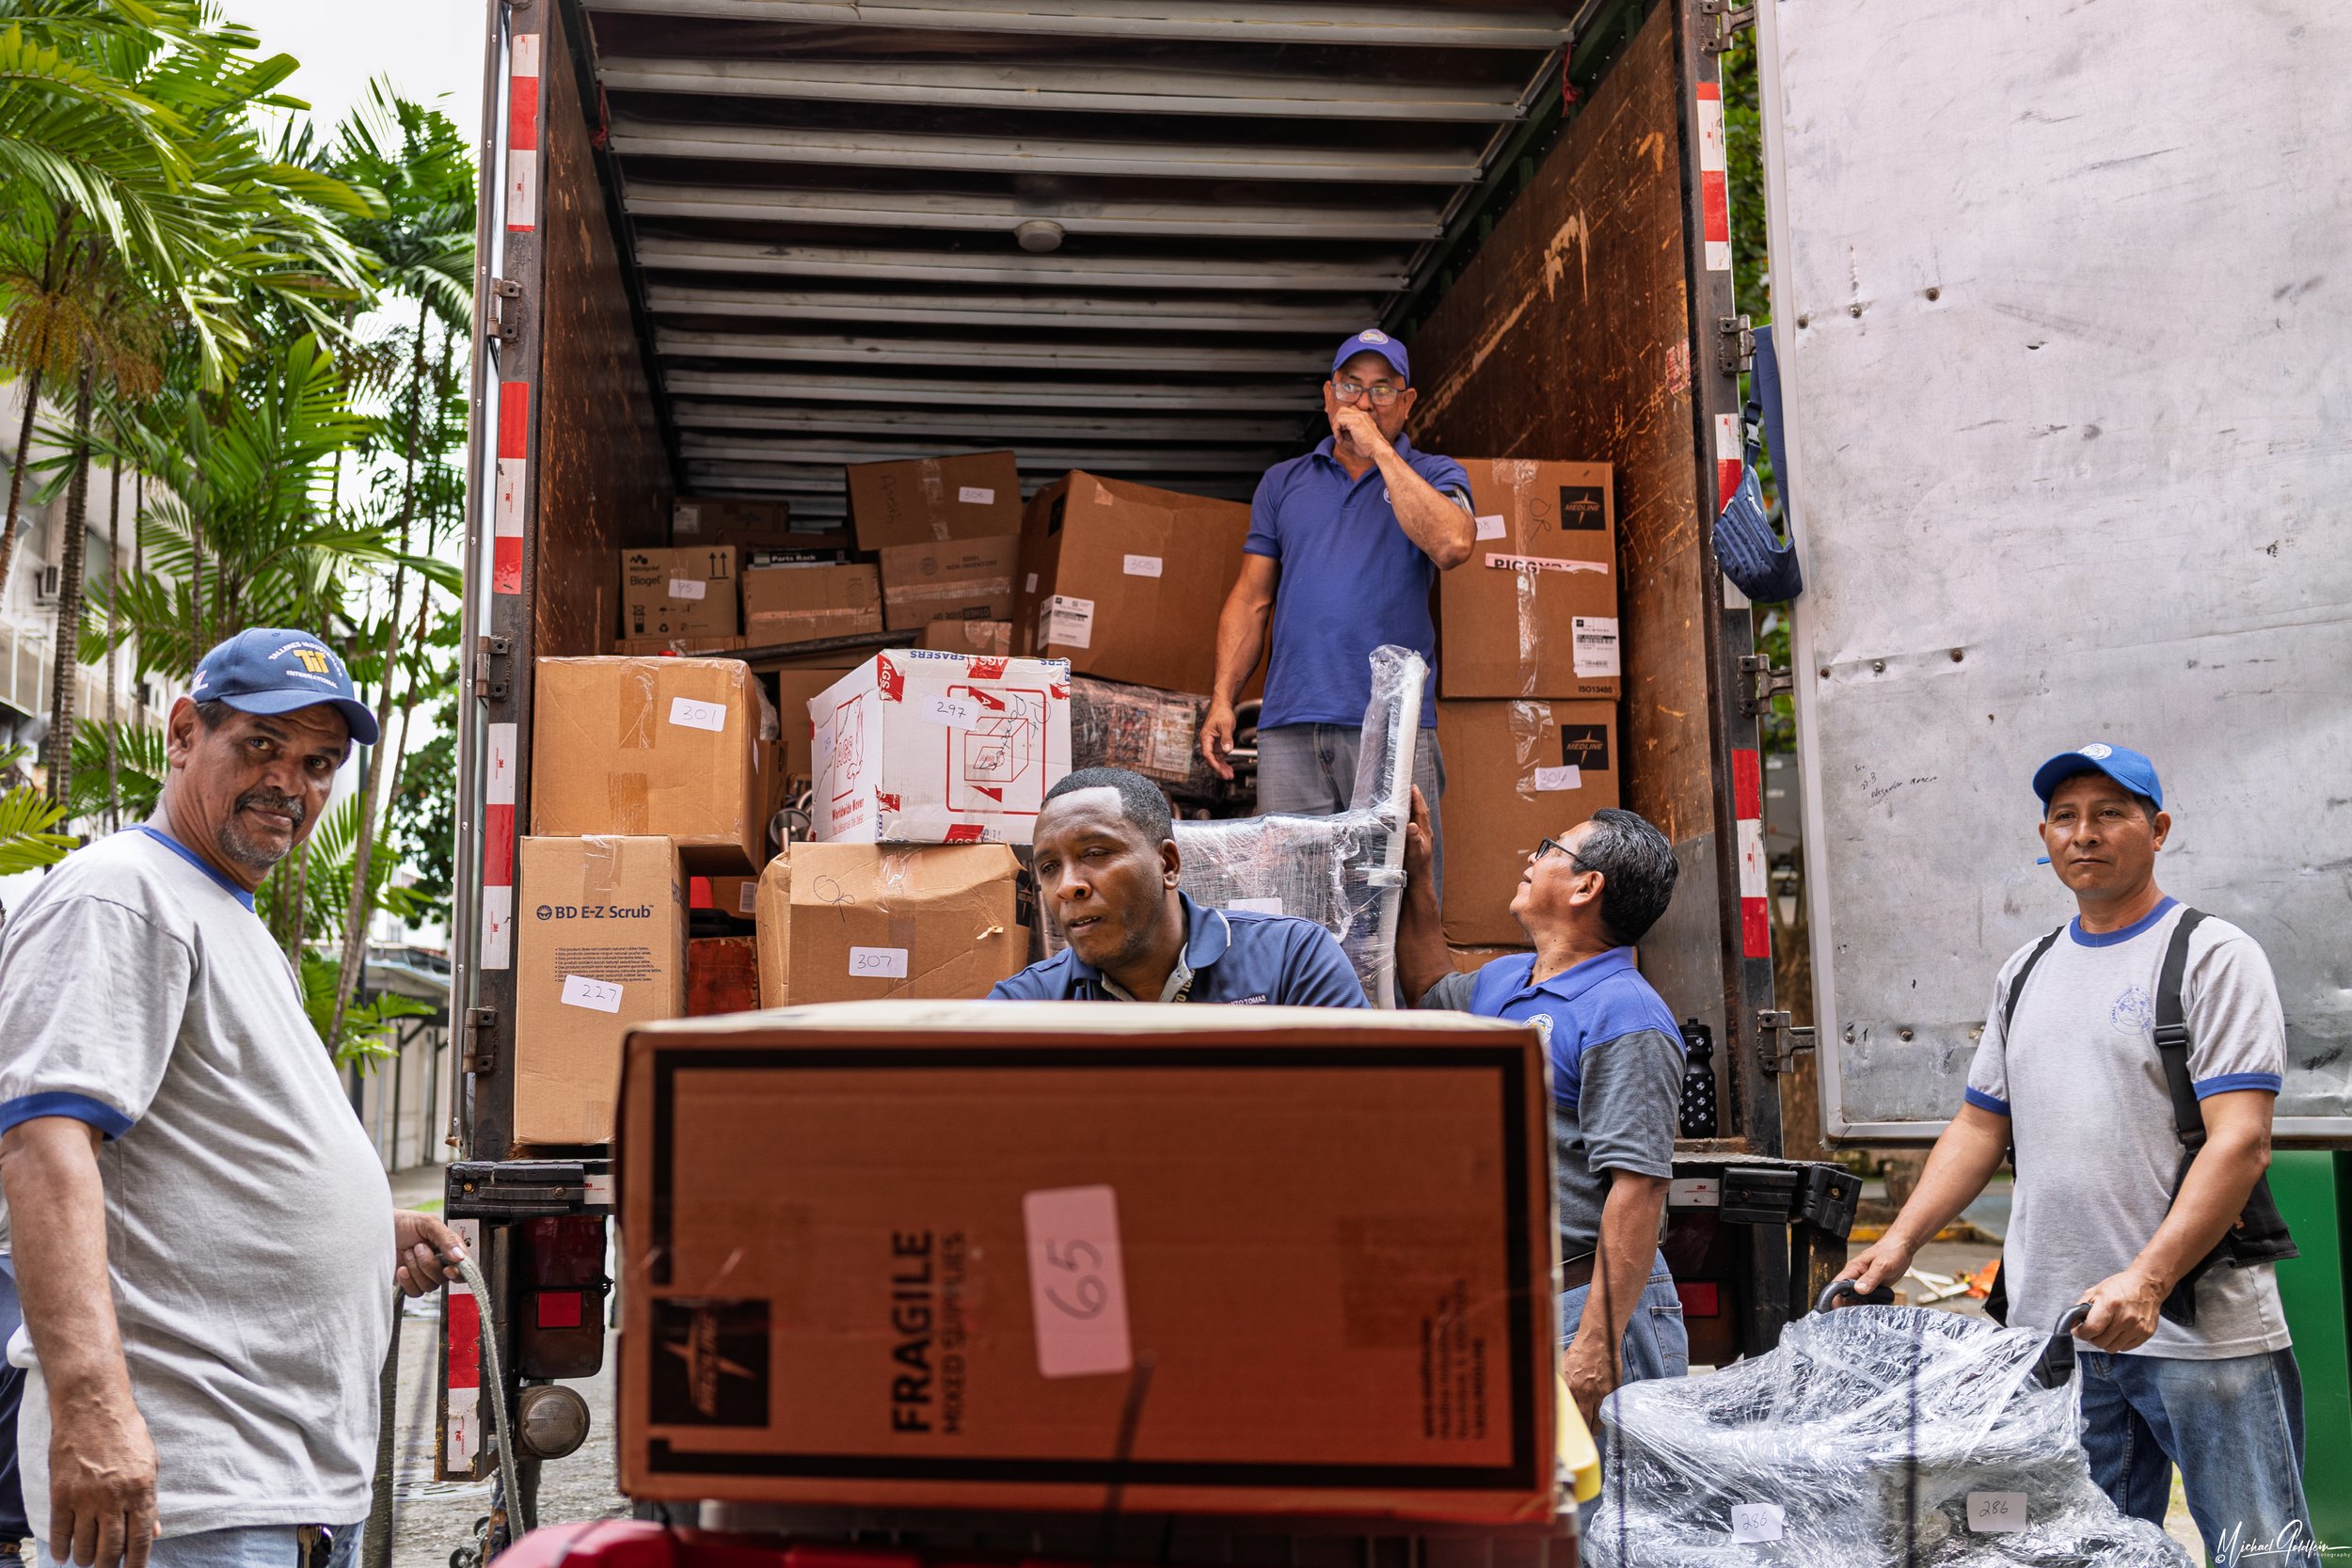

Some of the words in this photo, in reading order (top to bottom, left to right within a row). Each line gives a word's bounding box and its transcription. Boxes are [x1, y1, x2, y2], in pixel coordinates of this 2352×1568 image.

[630, 575, 661, 587] Biogel
[980, 657, 1006, 666] AGS
[882, 660, 893, 689] AGS
[682, 705, 719, 725] 301
[937, 702, 966, 719] 297
[832, 802, 851, 821] Worldwide
[852, 798, 865, 813] Mover
[555, 906, 578, 919] BD
[581, 906, 604, 919] E-Z
[857, 954, 892, 970] 307
[582, 984, 617, 1002] 227
[1244, 994, 1267, 1005] TOMAS
[1043, 1237, 1109, 1321] 65
[892, 1229, 932, 1434] FRAGILE
[1979, 1500, 2009, 1517] 286
[1741, 1511, 1768, 1530] 286
